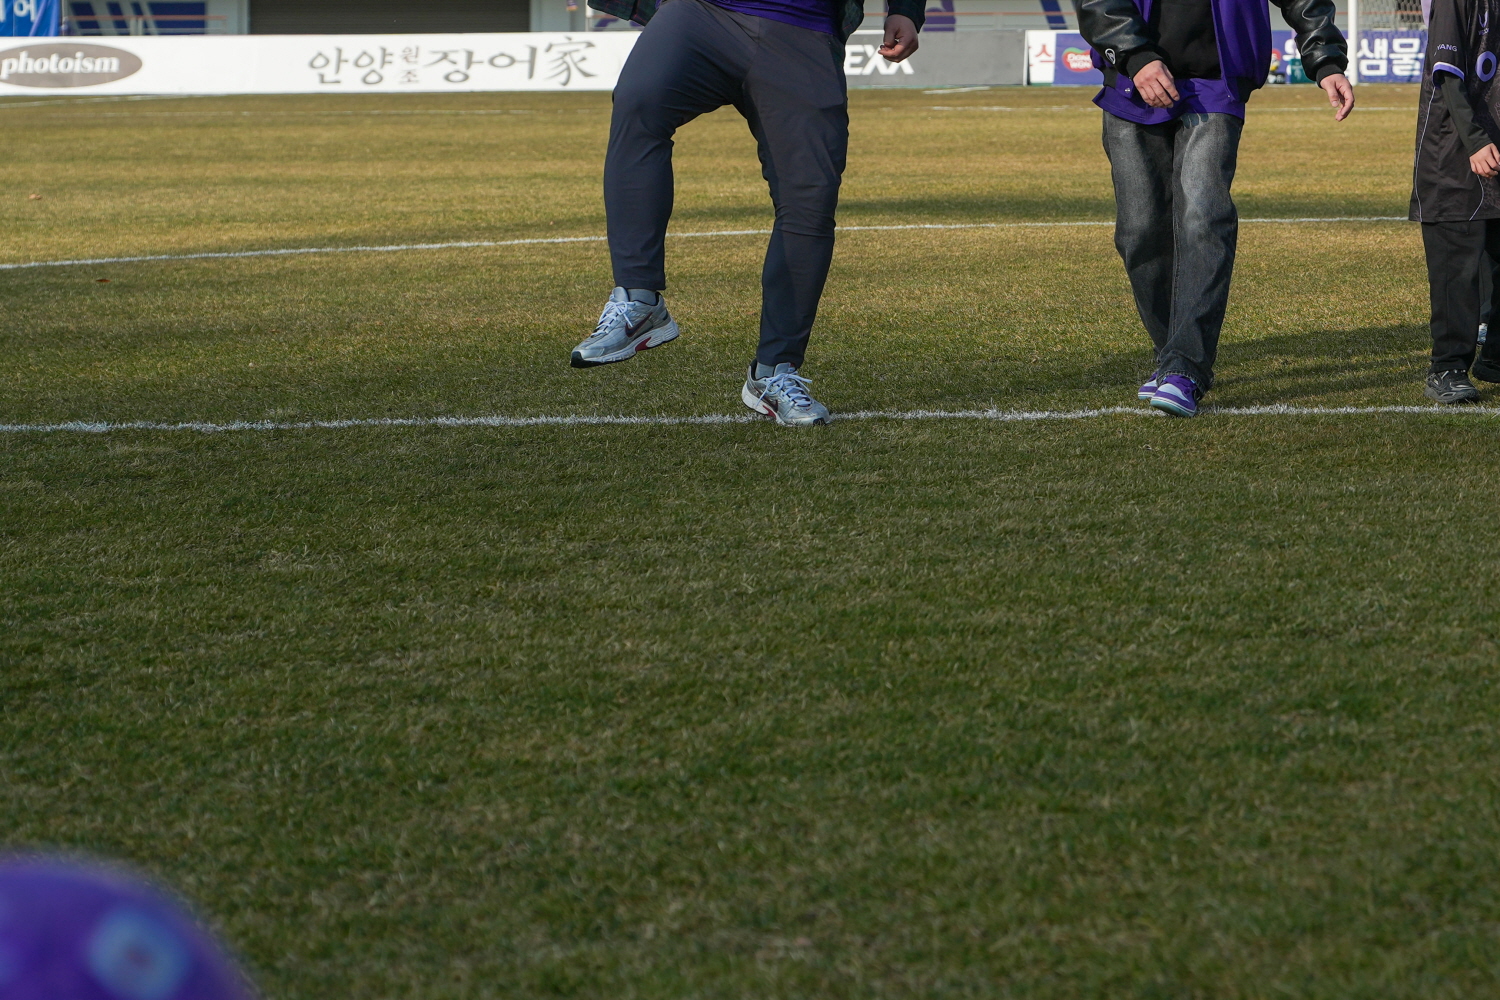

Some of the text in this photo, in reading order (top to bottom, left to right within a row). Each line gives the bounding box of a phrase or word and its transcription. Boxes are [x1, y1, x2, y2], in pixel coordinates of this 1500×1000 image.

[0, 50, 121, 80] photoism
[308, 46, 394, 85] 안양
[1356, 37, 1425, 76] 샘물
